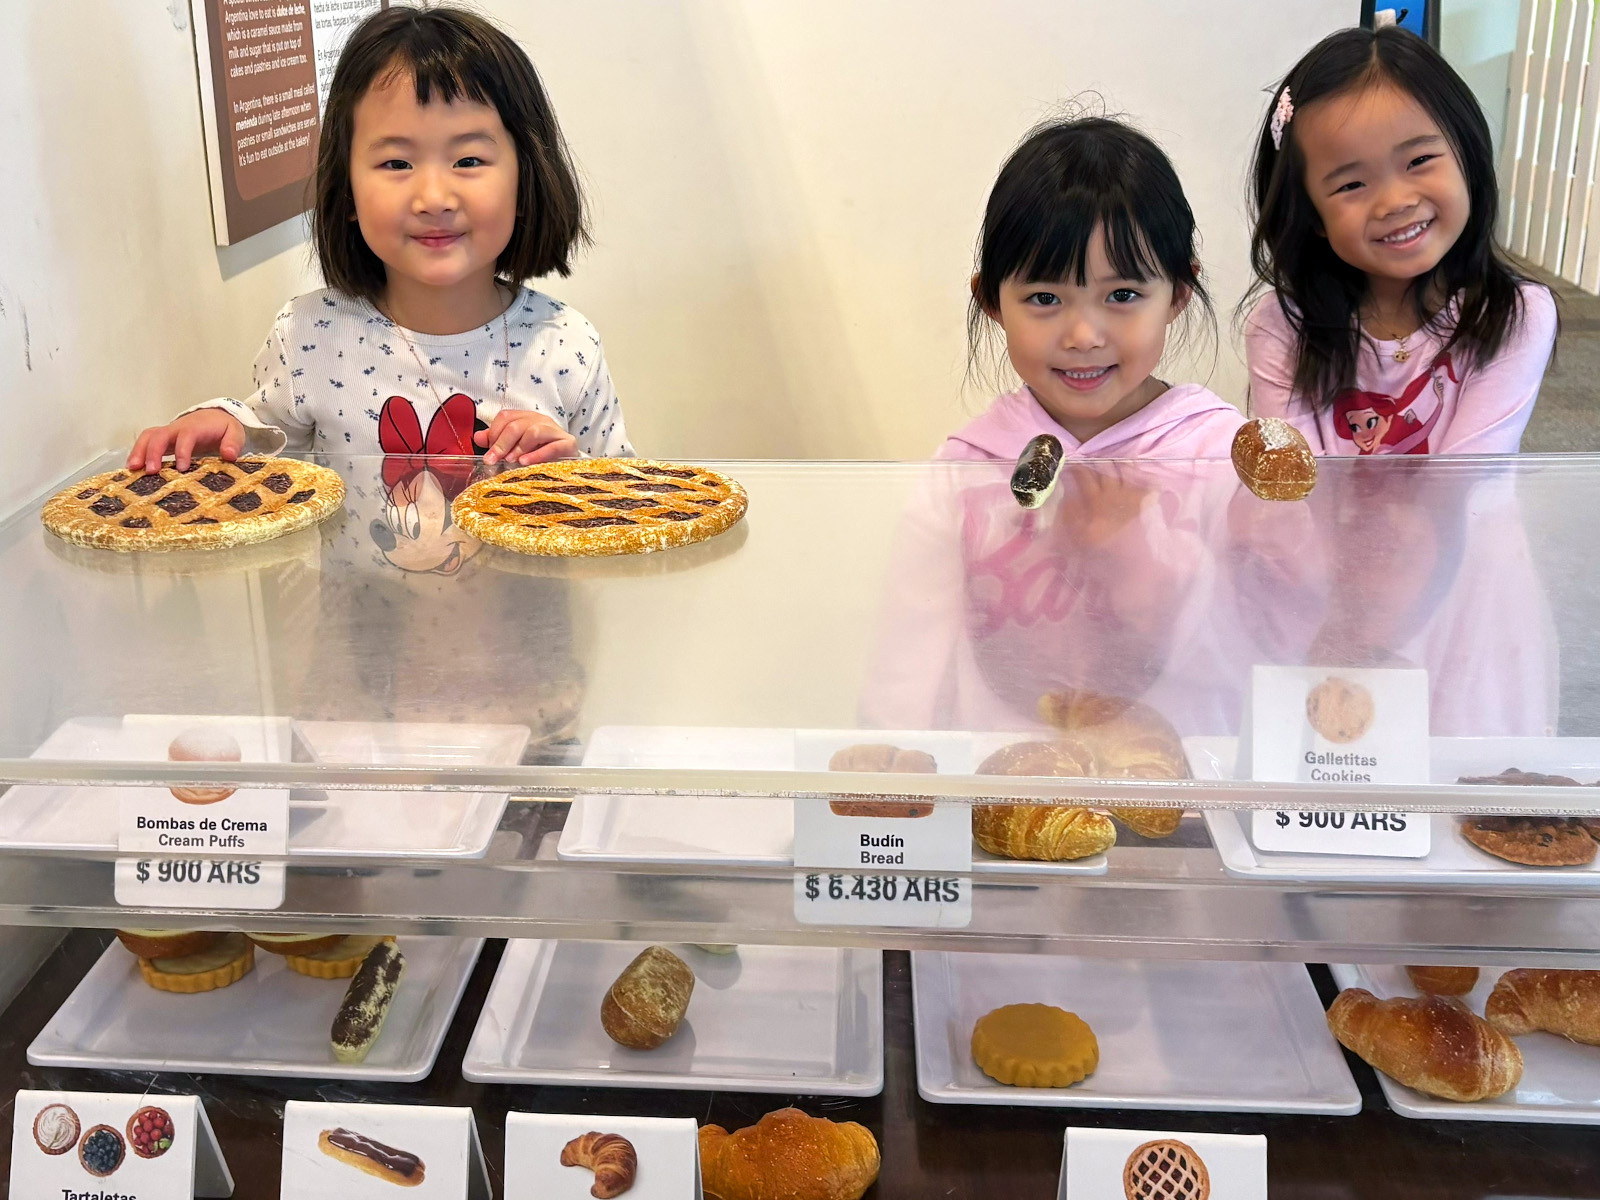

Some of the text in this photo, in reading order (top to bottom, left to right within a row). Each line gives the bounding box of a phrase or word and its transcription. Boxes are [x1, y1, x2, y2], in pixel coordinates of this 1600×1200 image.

[225, 9, 248, 25] Argentina
[248, 8, 258, 20] love
[259, 8, 264, 19] to
[264, 7, 272, 18] eat
[272, 6, 276, 18] is
[277, 5, 288, 17] dulce
[289, 4, 294, 15] de
[294, 3, 306, 15] leche,
[226, 28, 241, 41] which
[241, 27, 246, 39] is
[251, 24, 268, 38] caramel
[269, 26, 281, 36] sauce
[281, 21, 293, 33] made
[293, 20, 303, 32] from
[228, 46, 239, 59] milk
[240, 45, 249, 58] and
[249, 45, 262, 58] sugar
[262, 42, 271, 54] that
[271, 40, 276, 52] is
[284, 40, 290, 49] on
[297, 36, 302, 48] of
[230, 65, 244, 78] cakes
[244, 62, 253, 75] and
[254, 59, 271, 75] pastries
[272, 57, 280, 69] and
[287, 56, 299, 66] cream
[233, 101, 239, 113] In
[240, 97, 263, 114] Argentina,
[263, 95, 274, 106] there
[274, 92, 278, 103] is
[282, 88, 293, 101] small
[294, 86, 303, 98] meal
[303, 83, 315, 96] called
[236, 115, 258, 131] merienda
[258, 112, 272, 125] during
[272, 110, 280, 120] late
[281, 105, 300, 119] afternoon
[300, 101, 312, 113] when
[237, 134, 255, 151] pastries
[256, 133, 261, 143] or
[261, 127, 273, 142] small
[274, 122, 296, 138] sandwiches
[304, 116, 317, 129] served
[246, 152, 254, 164] fun
[254, 151, 260, 161] to
[260, 149, 268, 159] eat
[268, 141, 284, 157] outside
[1304, 751, 1377, 766] Galletitas
[1310, 768, 1371, 782] Cookies
[136, 816, 268, 832] Bombas de Crema
[1275, 811, 1407, 832] $ 900 ARS
[158, 834, 245, 848] Cream Puffs
[860, 834, 904, 848] Budín
[860, 851, 904, 865] Bread
[136, 860, 261, 885] $ 900 ARS
[805, 874, 960, 903] $ 6.430 ARS
[62, 1189, 137, 1200] Tartaletas
